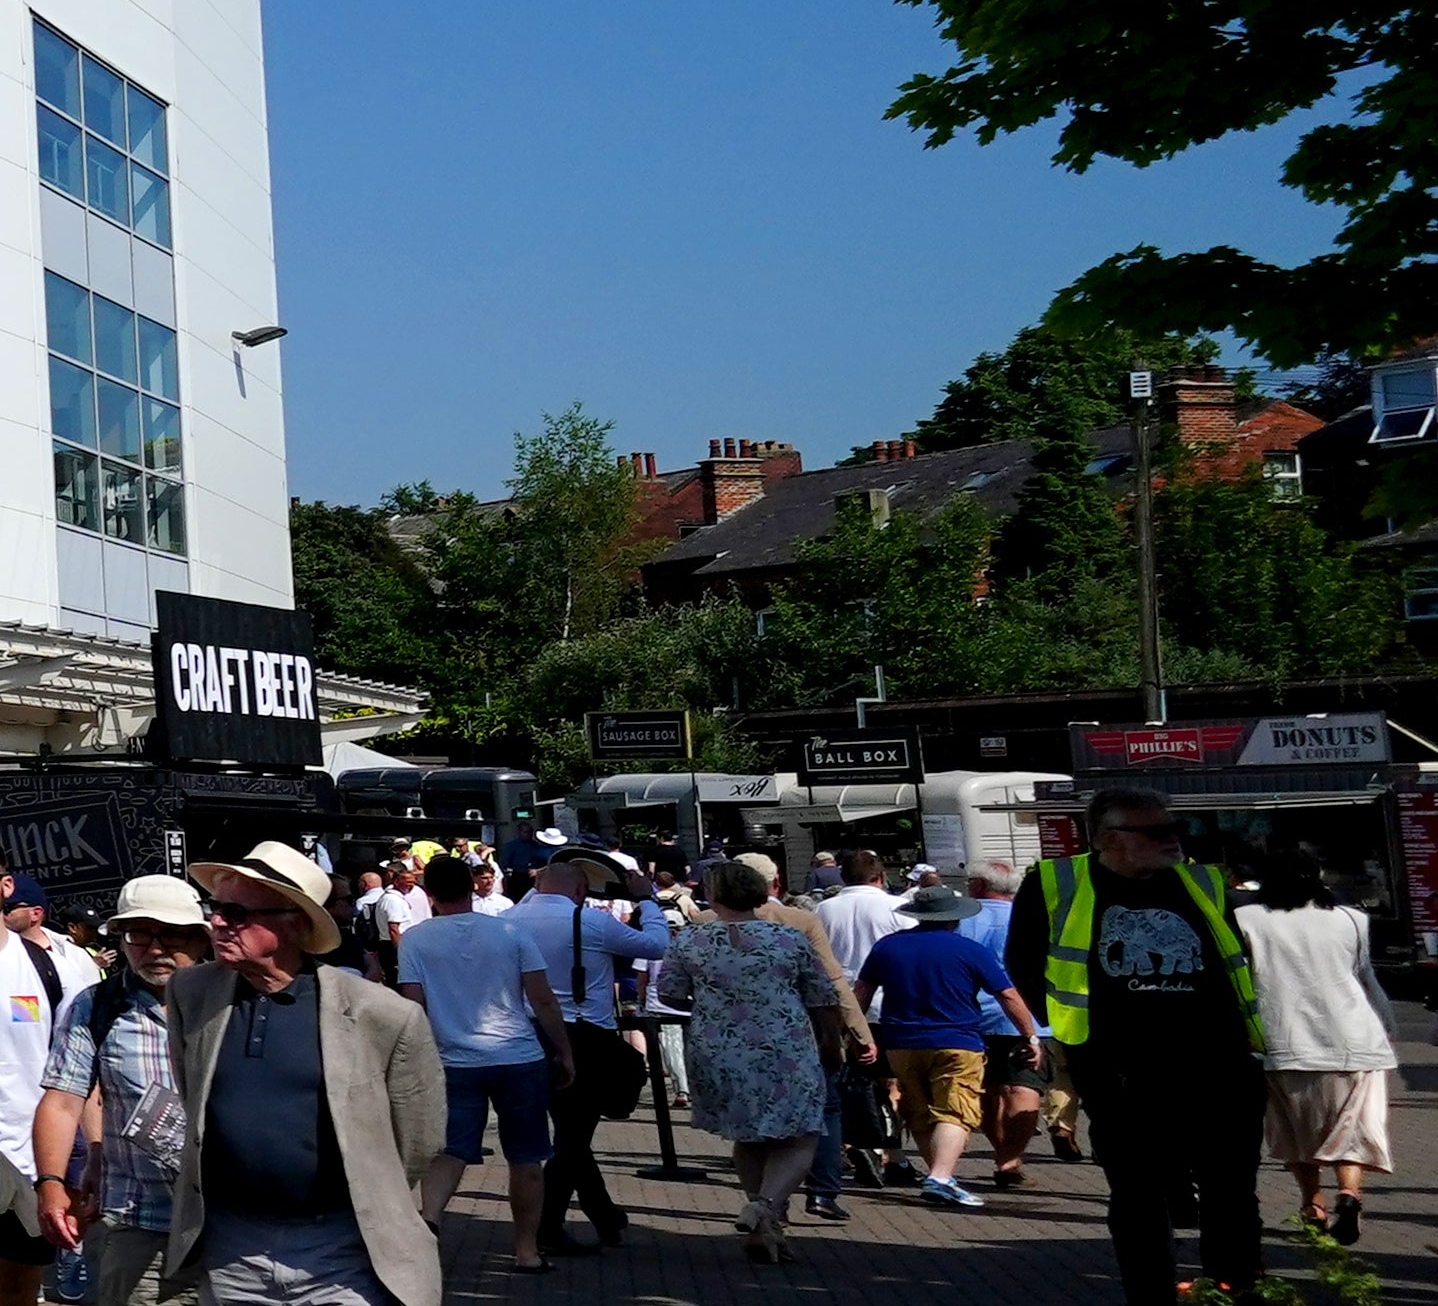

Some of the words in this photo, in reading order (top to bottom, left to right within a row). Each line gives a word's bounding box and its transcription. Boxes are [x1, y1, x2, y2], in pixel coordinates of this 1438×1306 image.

[170, 642, 250, 715] CRAFT
[252, 650, 315, 720] BEER
[603, 731, 651, 742] SAUSAGE
[654, 730, 676, 741] BOX
[1272, 725, 1377, 748] DONUTS
[1129, 740, 1197, 754] PHILLIE'S
[814, 752, 855, 764] BALL
[863, 750, 898, 763] BOX
